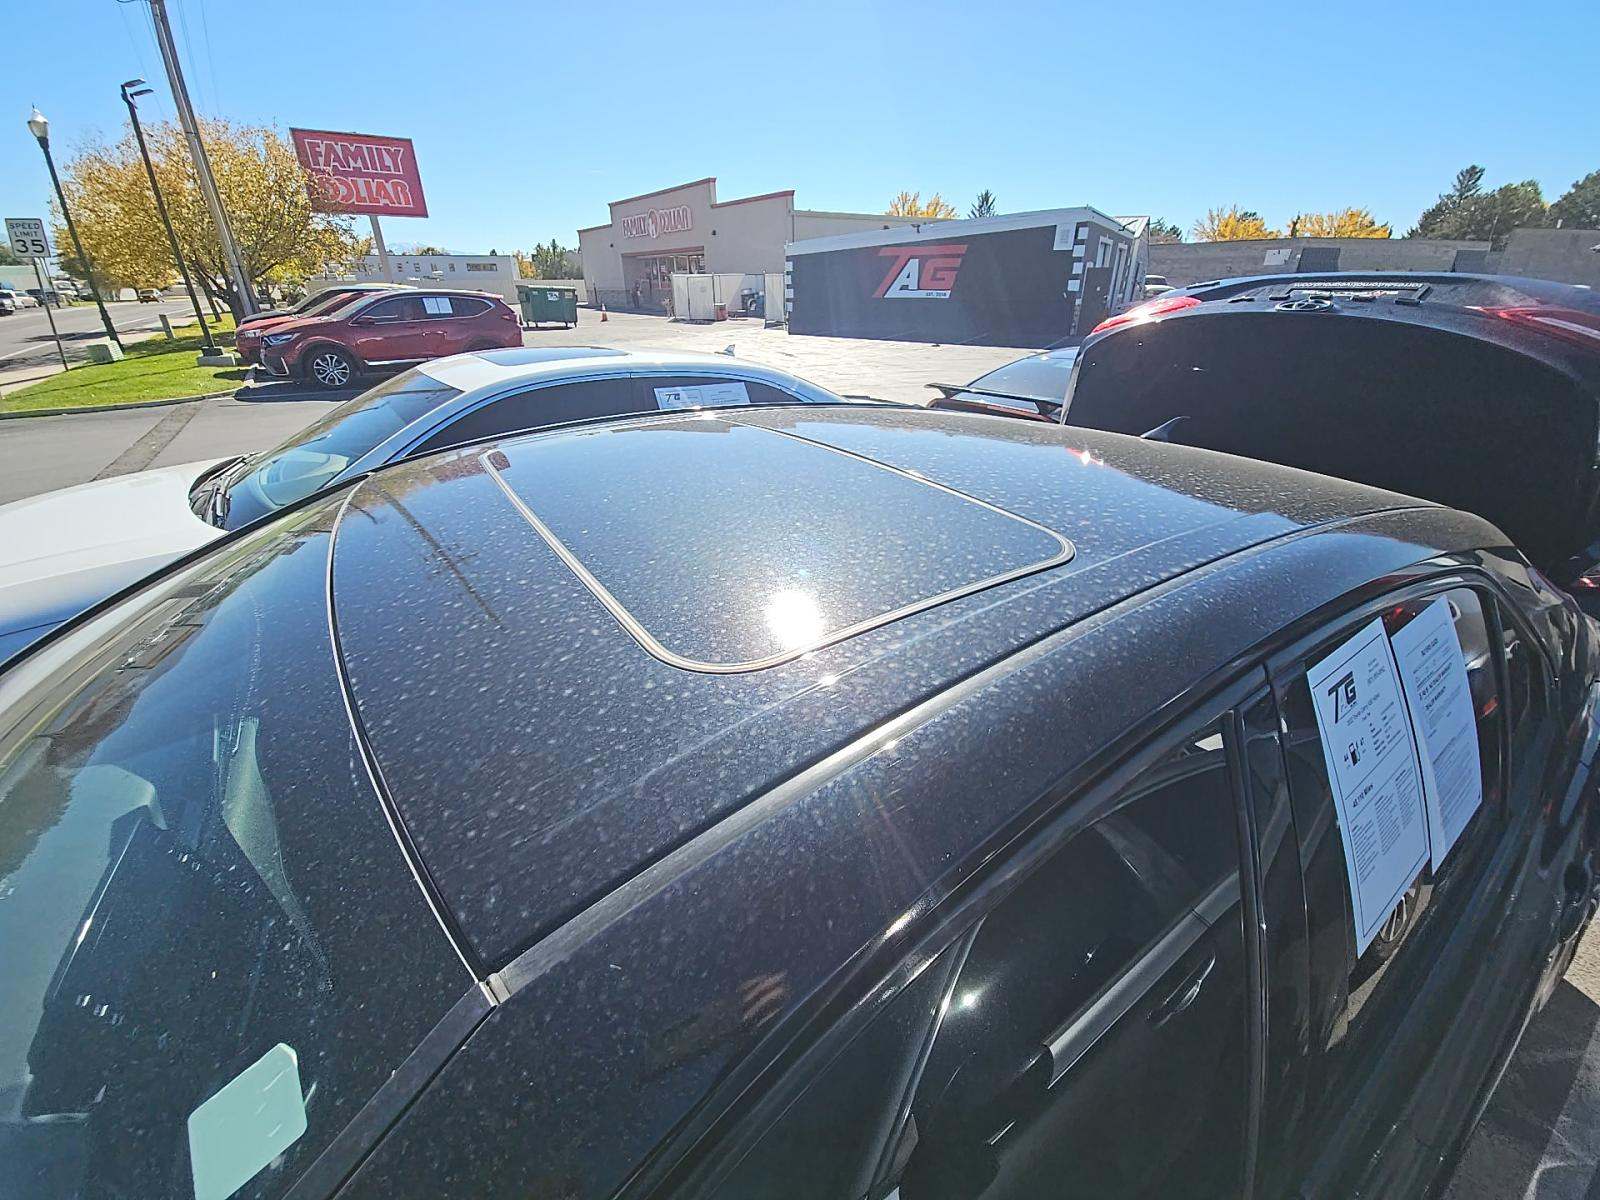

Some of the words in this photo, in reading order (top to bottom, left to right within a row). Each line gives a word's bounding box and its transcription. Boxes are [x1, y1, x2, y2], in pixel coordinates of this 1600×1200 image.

[304, 139, 403, 174] FAMILY
[622, 213, 649, 239] FAMILY
[15, 239, 45, 253] 35
